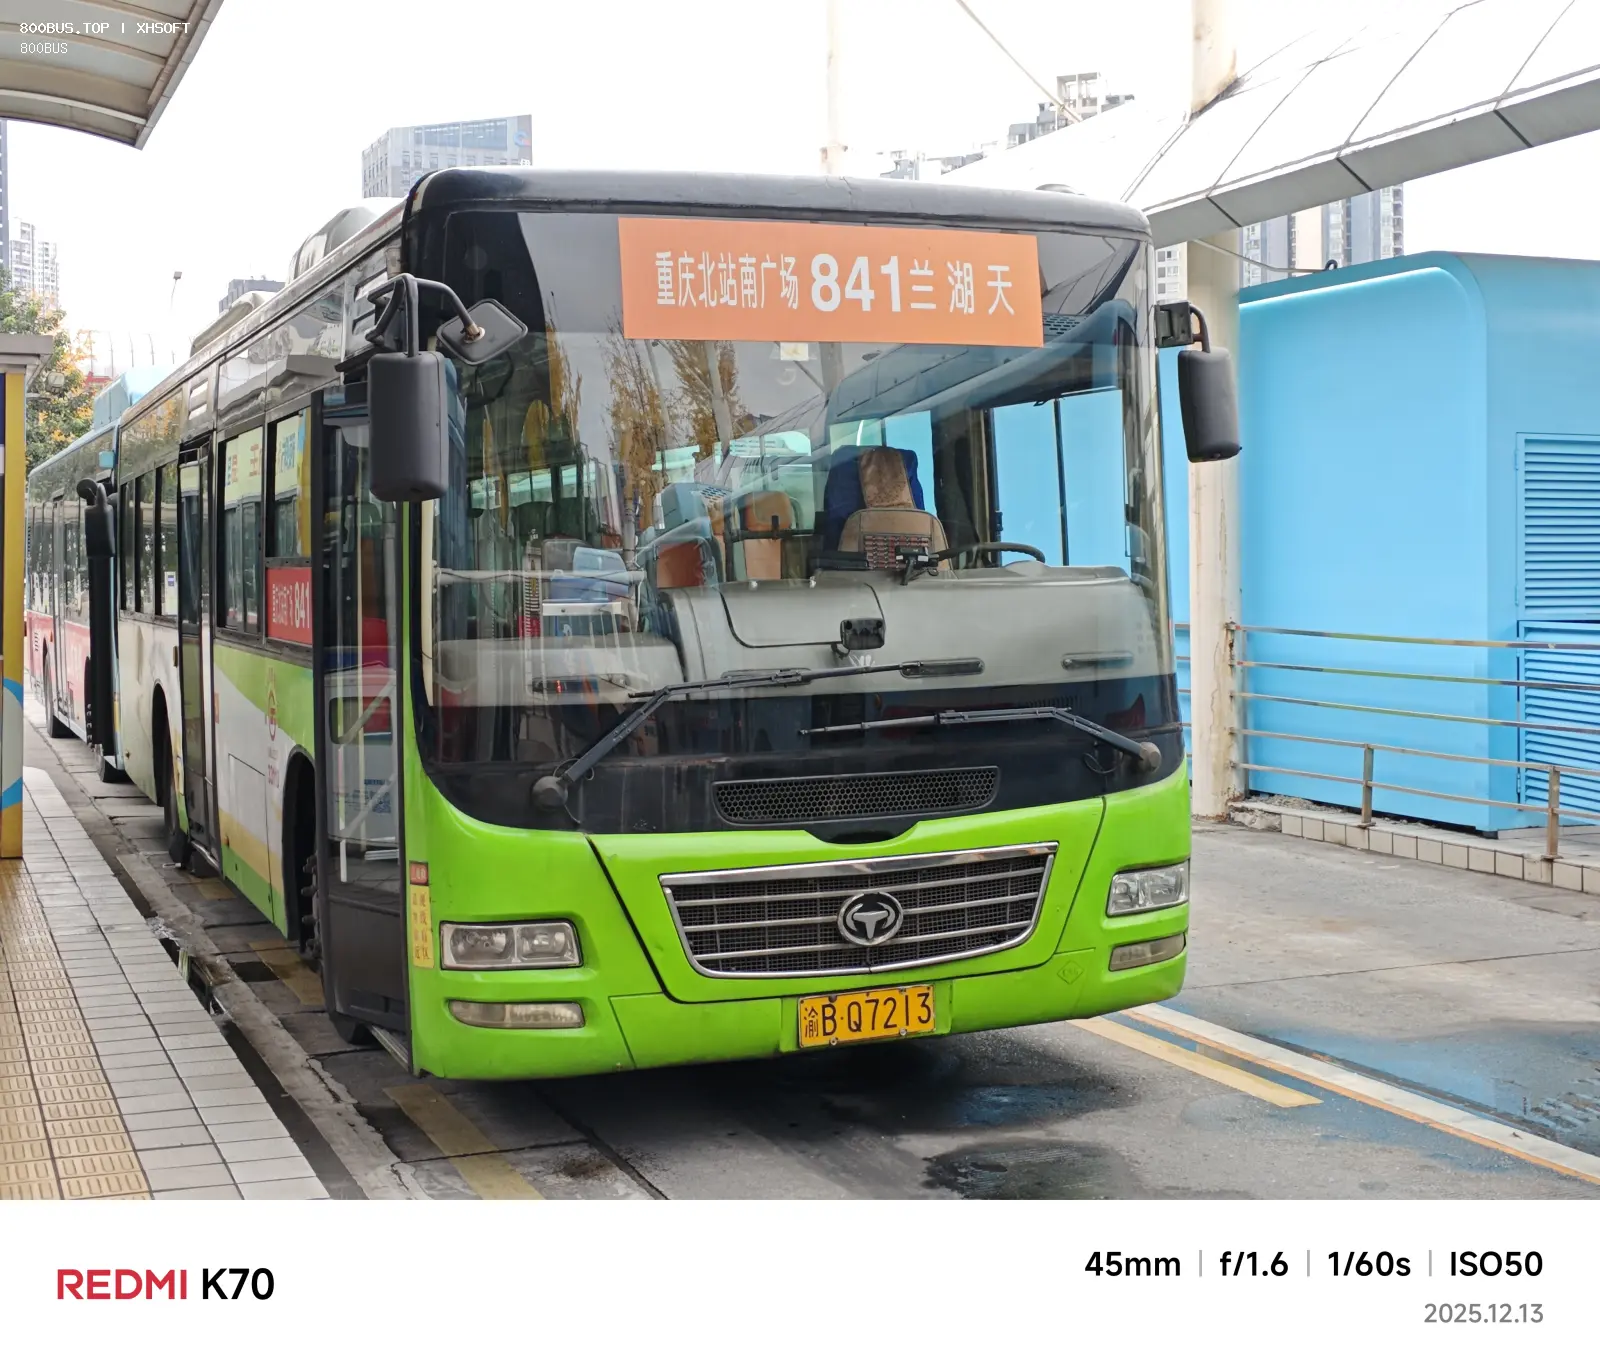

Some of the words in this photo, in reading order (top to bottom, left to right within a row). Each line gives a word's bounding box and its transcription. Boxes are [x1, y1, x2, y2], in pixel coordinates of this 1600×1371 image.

[655, 251, 799, 310] 重庆北站南广场
[811, 253, 901, 312] 841
[909, 259, 1015, 316] 兰湖天
[295, 581, 309, 629] 841
